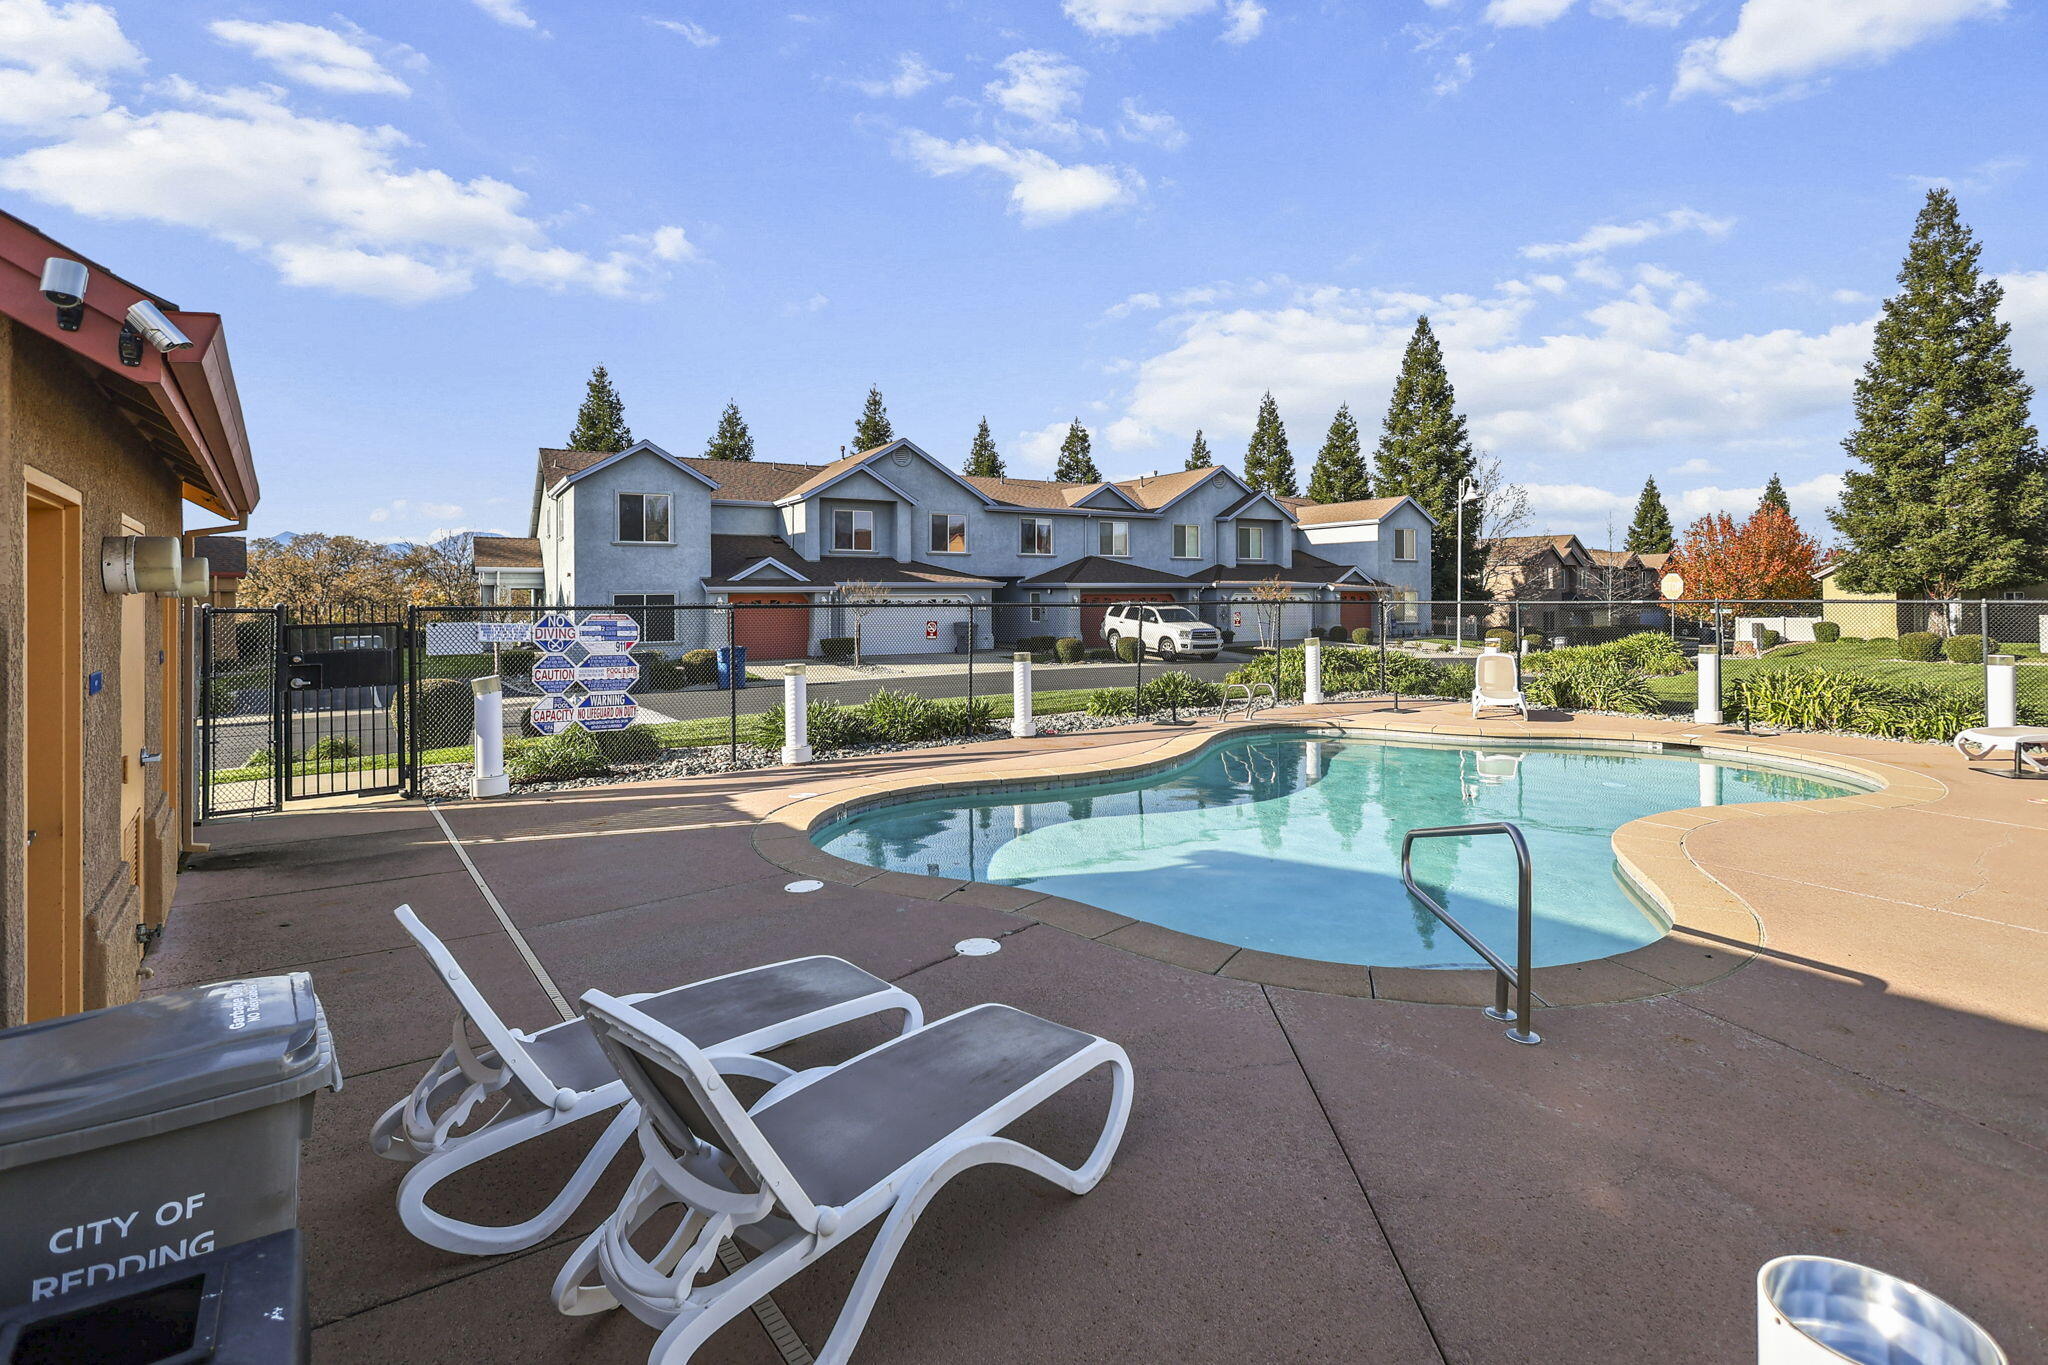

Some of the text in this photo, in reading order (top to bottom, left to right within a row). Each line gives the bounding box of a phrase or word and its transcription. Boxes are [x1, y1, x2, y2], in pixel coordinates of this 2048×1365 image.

[548, 616, 565, 627] NO
[535, 627, 576, 639] DIVING
[615, 641, 626, 652] 911
[535, 669, 575, 681] CAUTION
[590, 694, 625, 707] WARNING
[533, 709, 574, 721] CAPACITY
[577, 706, 637, 718] NO LIFEGUARD ON DUTY
[229, 997, 246, 1029] Garbage
[247, 1012, 261, 1022] NO
[49, 1192, 206, 1254] CITY OF
[32, 1230, 215, 1302] REDDING
